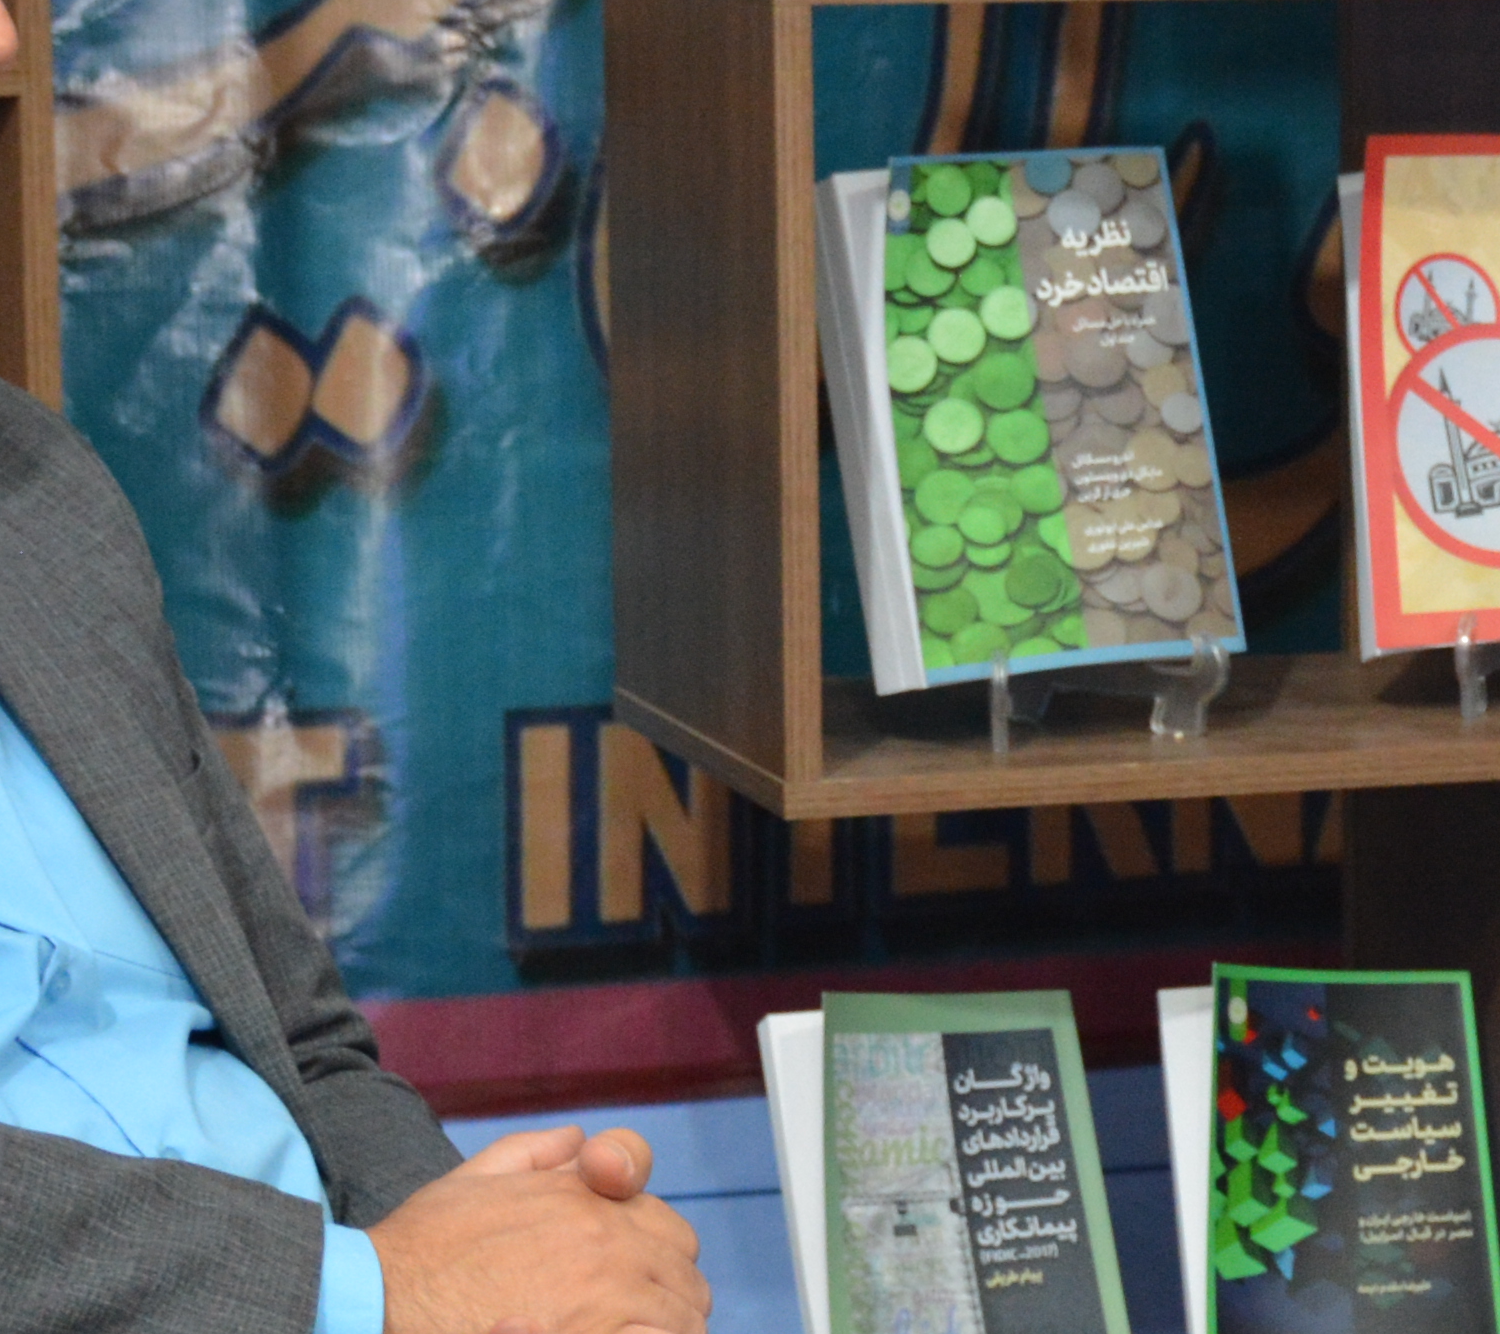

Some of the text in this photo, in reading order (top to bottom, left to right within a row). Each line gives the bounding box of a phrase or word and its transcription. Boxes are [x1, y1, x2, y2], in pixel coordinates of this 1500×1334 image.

[1061, 220, 1132, 257] نظریه
[1036, 261, 1169, 307] اقتصاد خرد
[954, 1062, 1051, 1094] واژگان
[1344, 1053, 1455, 1082] هویت و
[958, 1094, 1055, 1127] پرکاربرد
[1348, 1081, 1459, 1114] تغییر
[962, 1122, 1061, 1155] قراردادهای
[1350, 1116, 1463, 1145] سیاست
[967, 1156, 1066, 1187] بین المللی
[1353, 1147, 1465, 1182] خارجی
[970, 1189, 1070, 1216] حوزه
[977, 1217, 1078, 1246] پیمانکاری
